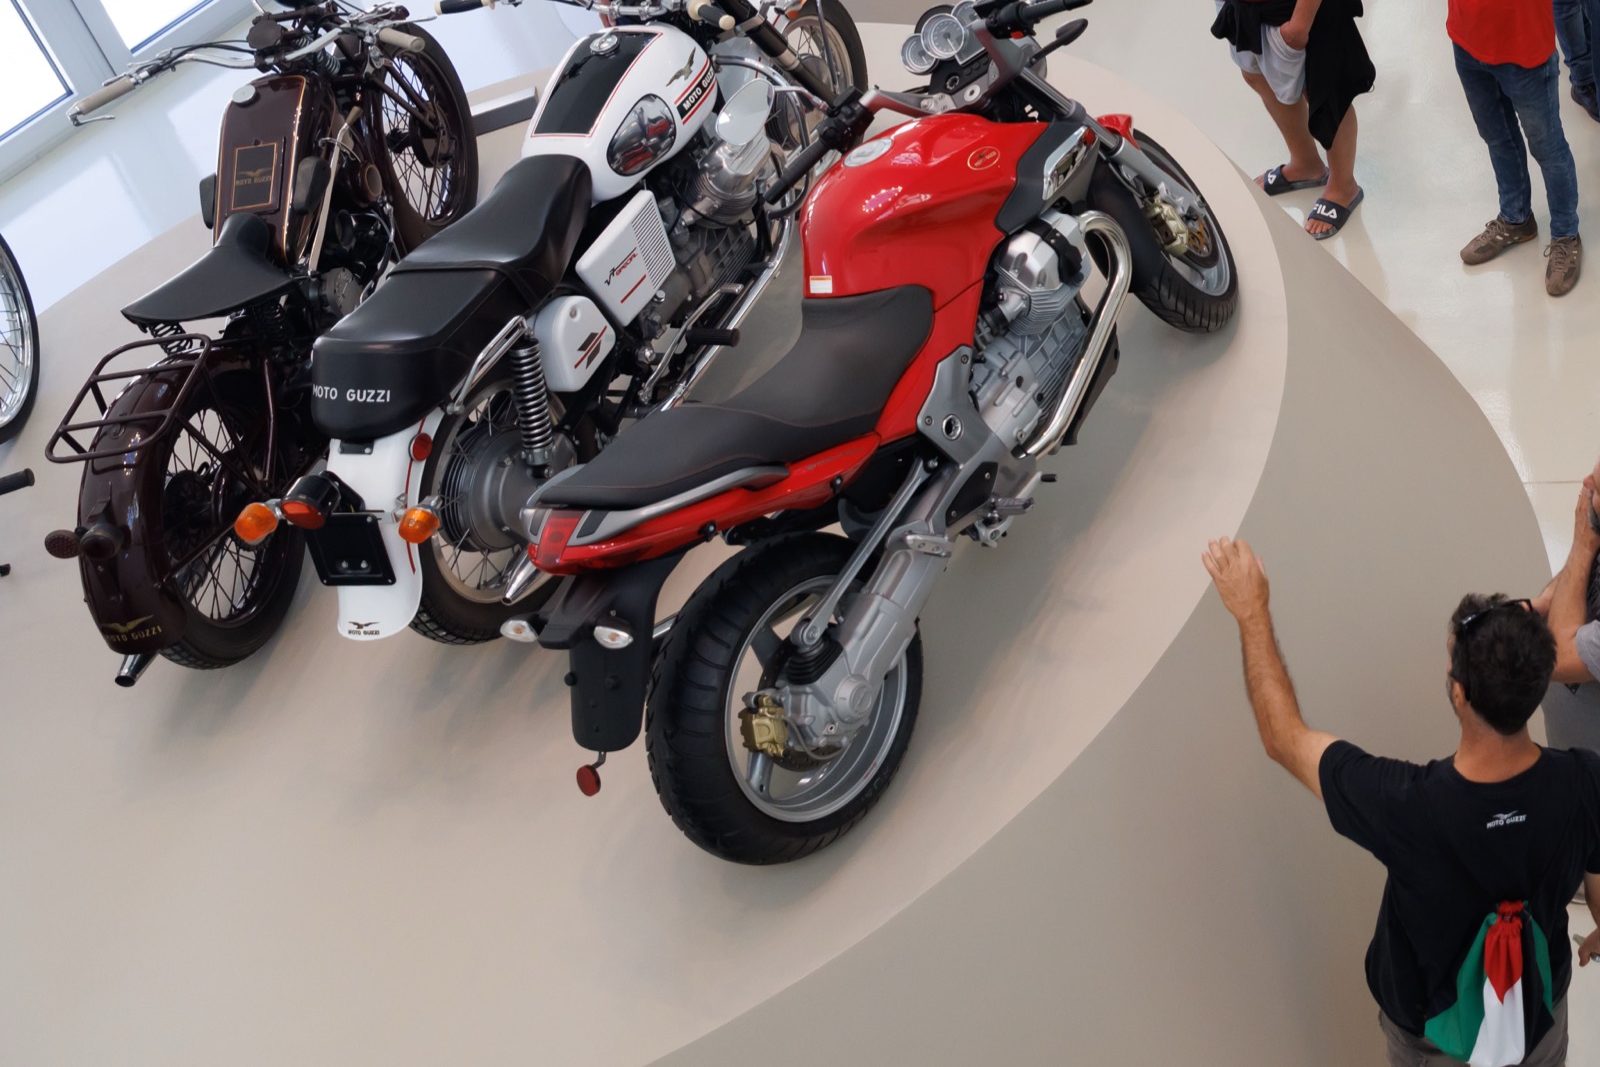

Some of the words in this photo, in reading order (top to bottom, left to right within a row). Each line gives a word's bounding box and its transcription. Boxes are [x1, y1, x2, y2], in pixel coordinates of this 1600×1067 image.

[682, 87, 703, 110] MOTO
[312, 383, 338, 400] MOTO
[346, 388, 391, 403] GUZZI
[131, 625, 162, 641] GUZZI
[1487, 819, 1504, 829] MOTO
[1506, 814, 1527, 825] GUZZI
